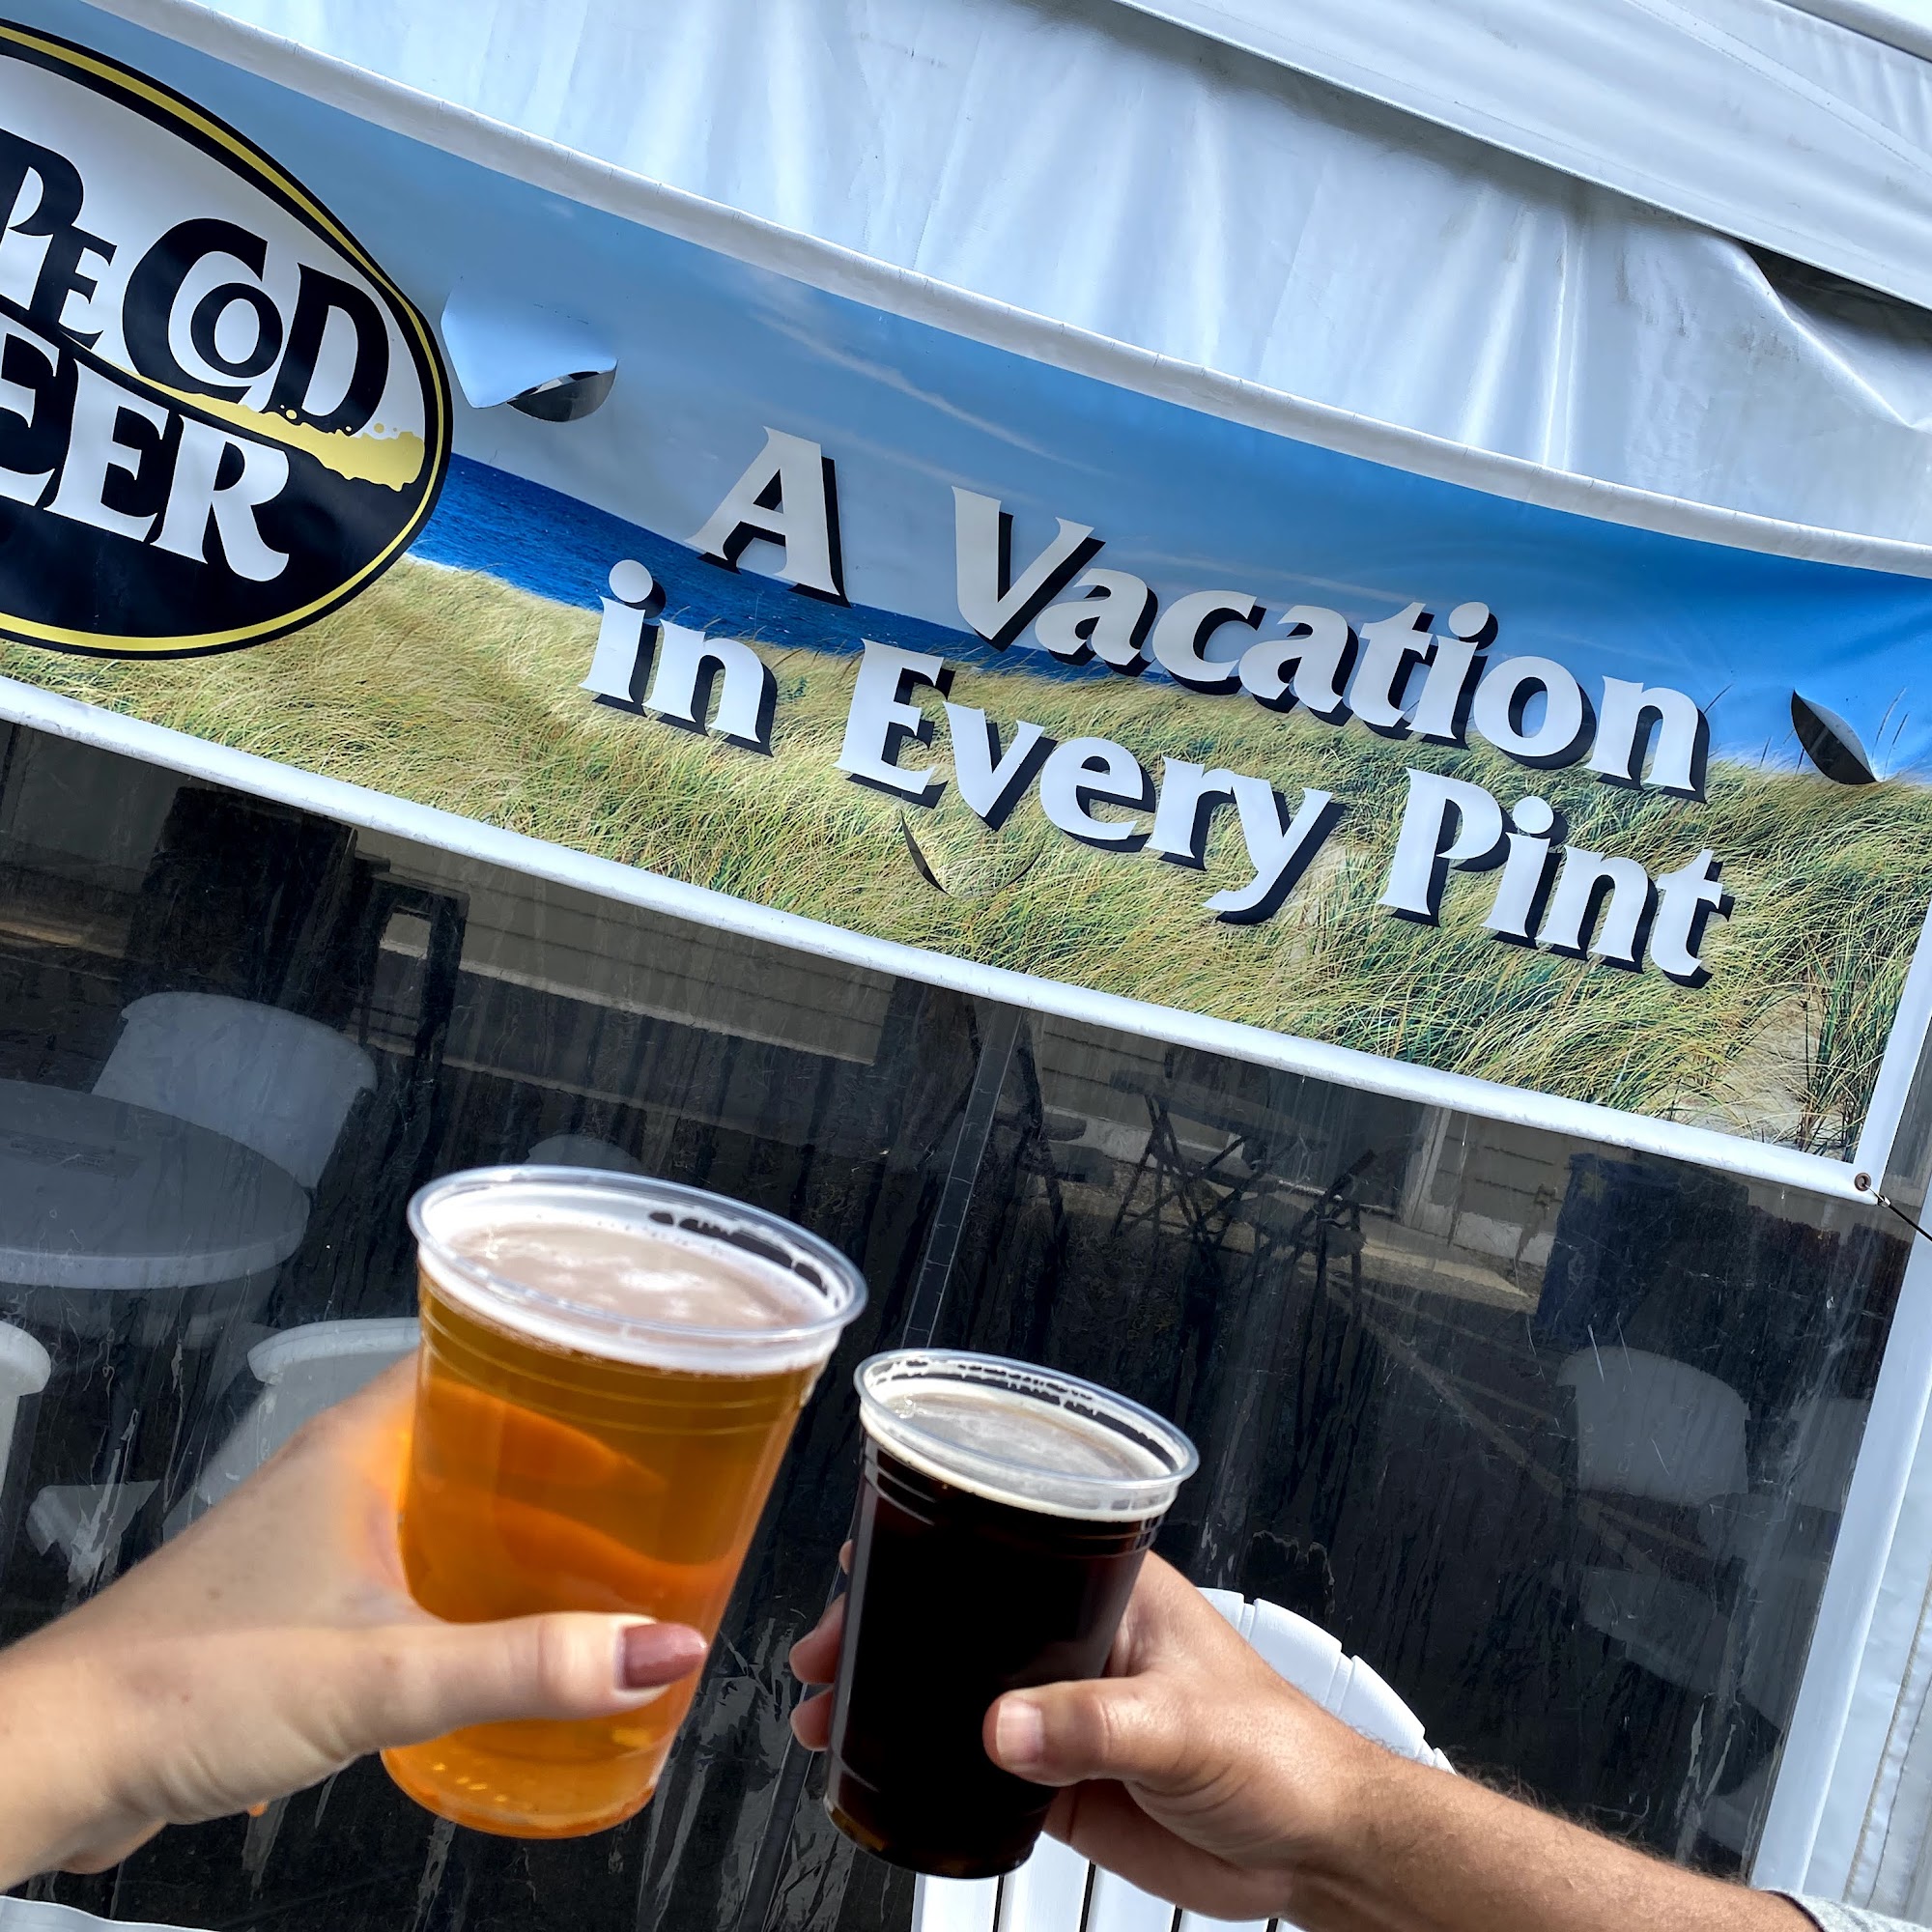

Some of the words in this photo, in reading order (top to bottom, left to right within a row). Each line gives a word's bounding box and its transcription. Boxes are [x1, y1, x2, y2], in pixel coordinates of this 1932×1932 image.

[122, 217, 390, 438] COD
[580, 559, 777, 757] in
[833, 639, 1348, 924] Every
[1378, 768, 1734, 988] Pint
[685, 426, 850, 607] A
[952, 486, 1710, 803] Vacation
